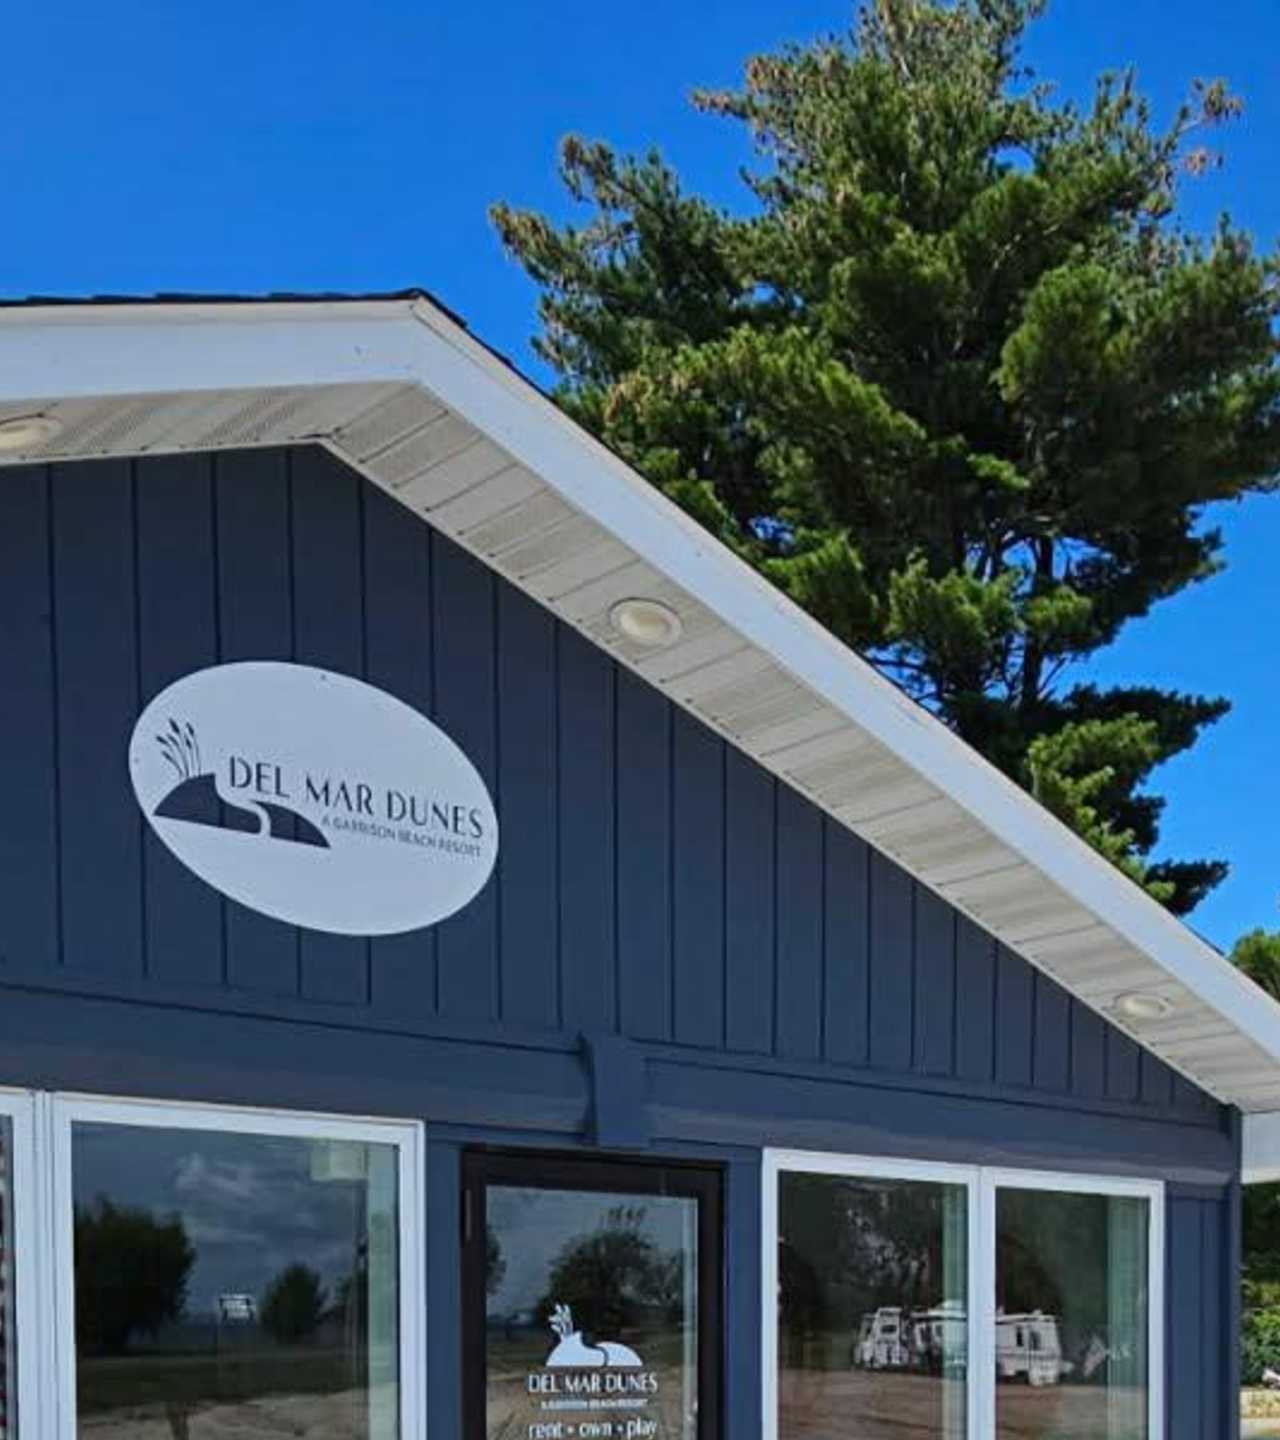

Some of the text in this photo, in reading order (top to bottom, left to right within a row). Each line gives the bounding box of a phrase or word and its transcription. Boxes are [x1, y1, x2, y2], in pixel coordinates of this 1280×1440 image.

[229, 755, 483, 839] DEL MAR DUNES
[528, 1371, 658, 1394] DEL MAR DUNES
[528, 1416, 658, 1440] rent own play
